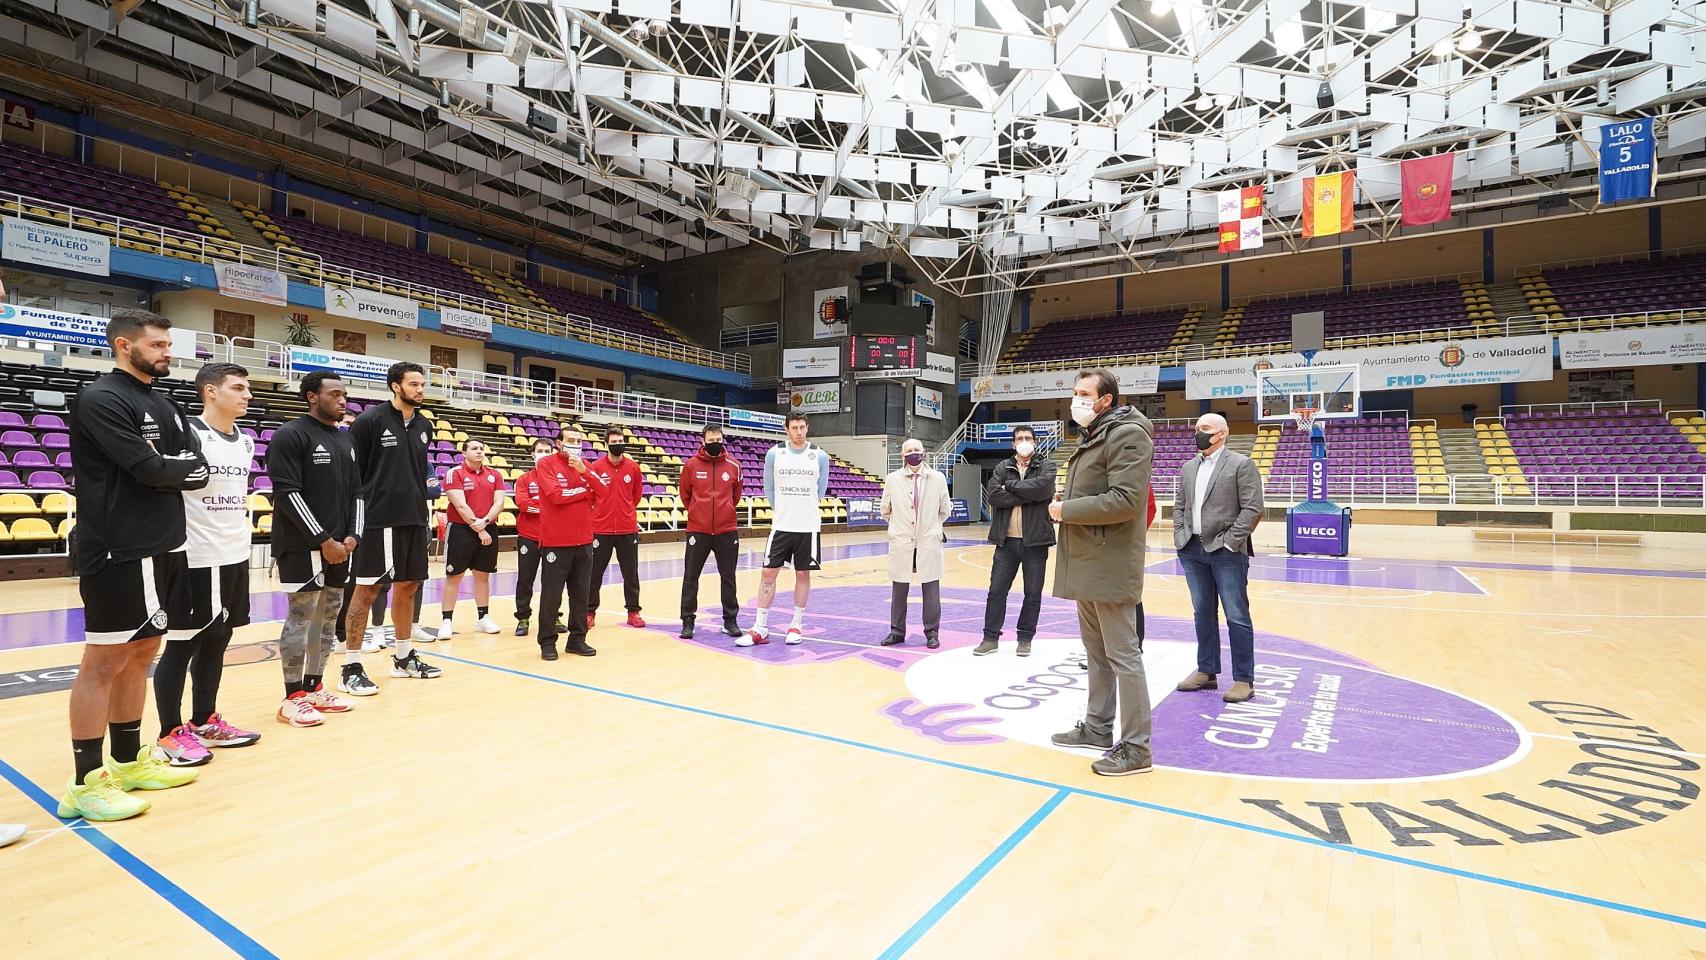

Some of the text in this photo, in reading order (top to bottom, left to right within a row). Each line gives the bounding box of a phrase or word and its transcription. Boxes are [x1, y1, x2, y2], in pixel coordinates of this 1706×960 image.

[8, 105, 30, 128] A
[1609, 123, 1643, 138] LALO
[1619, 146, 1632, 163] 5
[1604, 163, 1650, 175] VALLADOLID
[9, 223, 36, 233] CENTRO
[37, 228, 74, 240] DEPORTIVO
[27, 233, 88, 251] EL PALERO
[63, 252, 101, 264] supera
[224, 267, 273, 283] Hipocrates
[20, 310, 92, 325] Fundación
[358, 302, 416, 320] prevenges
[25, 330, 85, 343] AYUNTAMIENTO
[292, 351, 330, 364] FMD
[1363, 346, 1546, 367] Ayuntamiento de Valladolid
[1191, 368, 1246, 377] Ayuntamiento
[1430, 368, 1521, 379] Fundación Municipal
[1386, 374, 1427, 387] FMD
[1460, 376, 1501, 384] Deportes
[1211, 385, 1244, 397] FMD
[730, 410, 751, 419] FMD
[209, 465, 248, 477] aspas
[778, 468, 814, 477] aspasia
[1312, 462, 1322, 499] IVECO
[1297, 527, 1337, 536] IVECO
[1313, 673, 1343, 691] salud
[1291, 711, 1340, 754] Expertos
[1241, 700, 1702, 847] VALLADOLID
